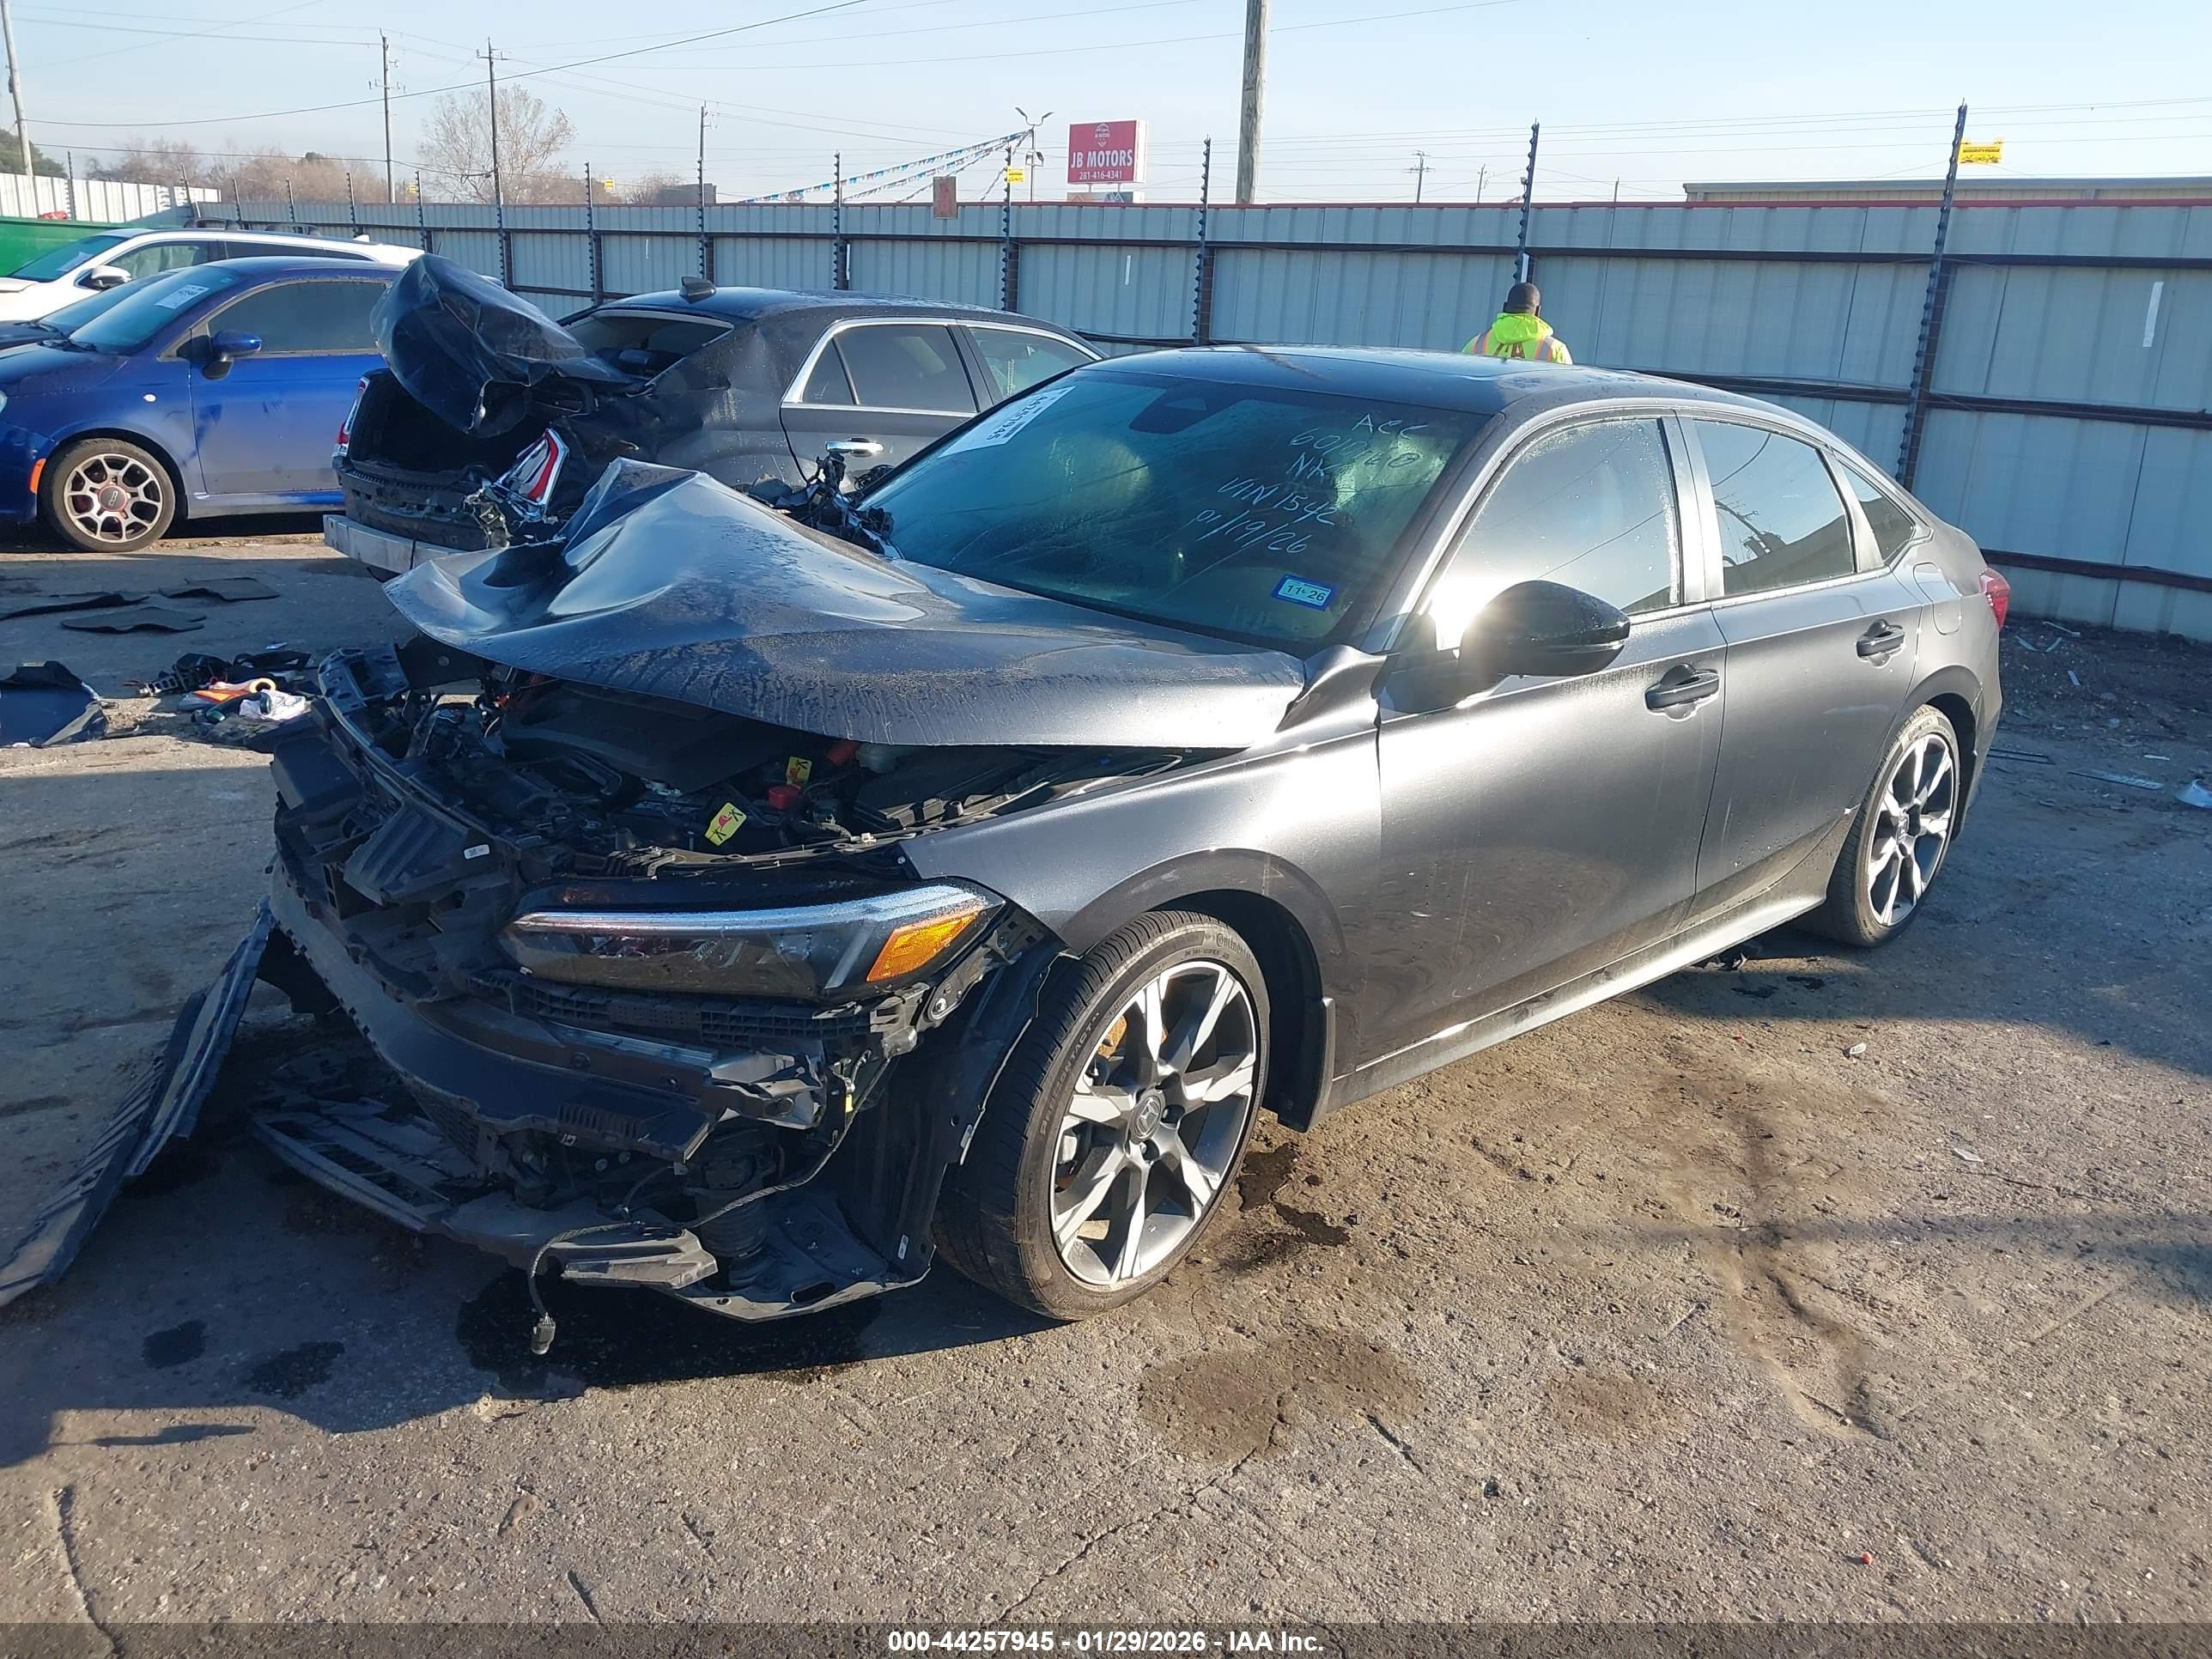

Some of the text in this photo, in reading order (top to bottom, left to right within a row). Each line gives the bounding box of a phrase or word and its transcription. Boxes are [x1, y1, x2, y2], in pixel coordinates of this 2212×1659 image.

[1071, 149, 1133, 168] JB MOTORS
[1217, 477, 1337, 526] VIN 1542
